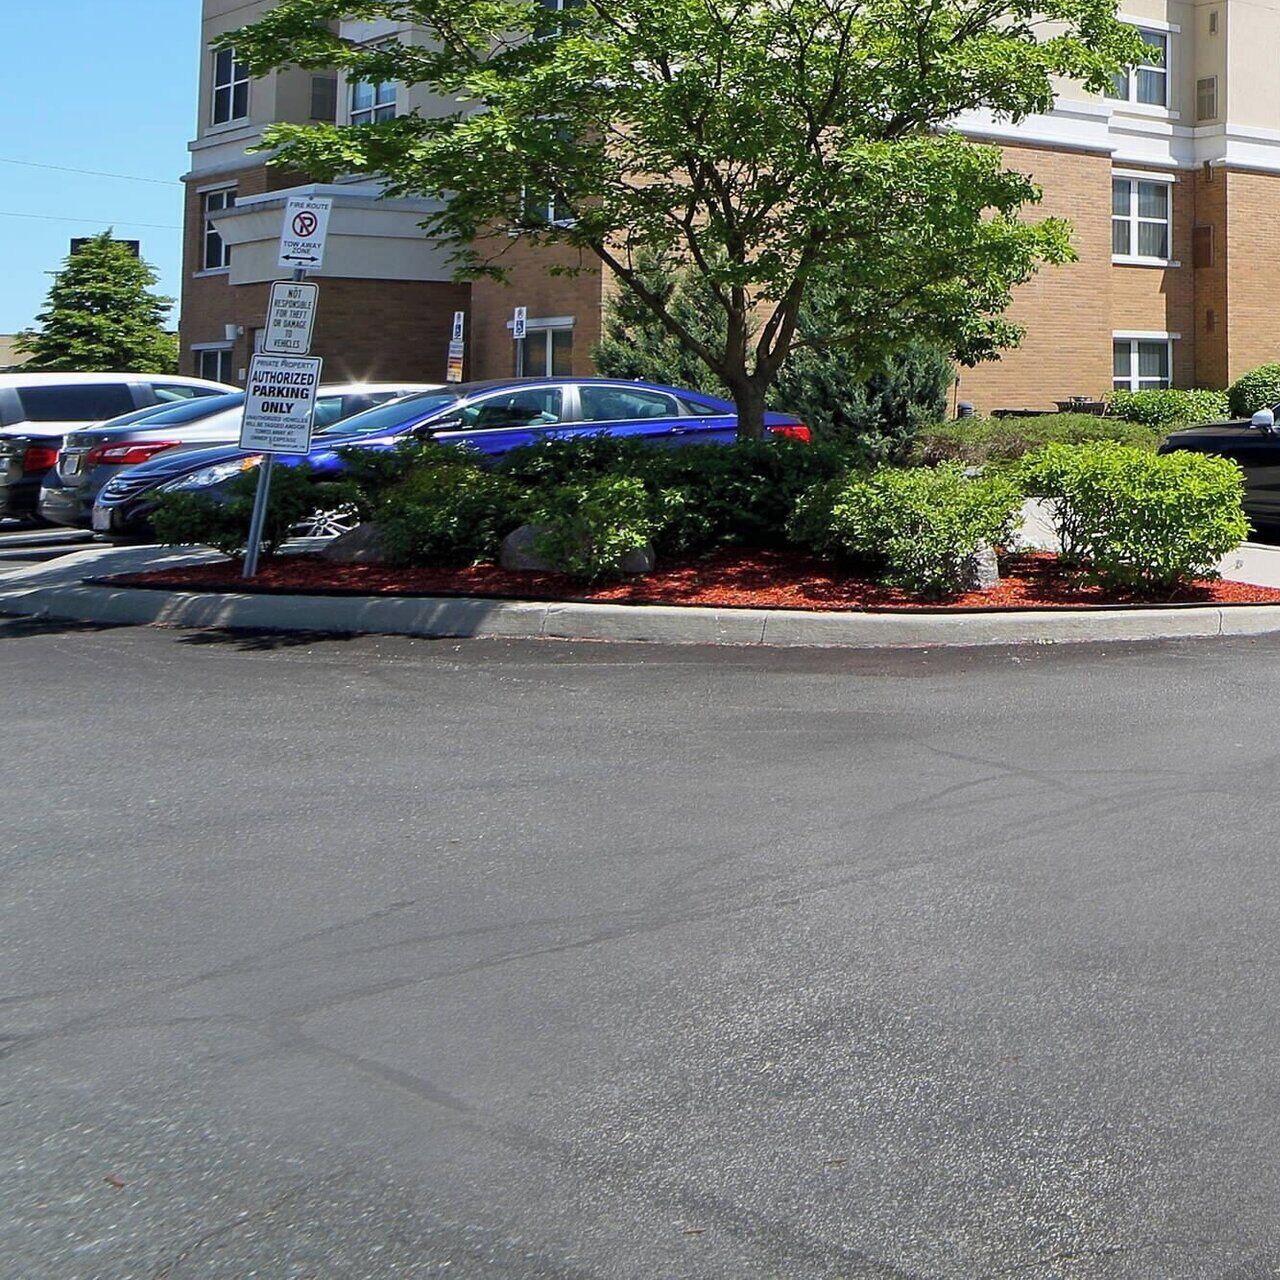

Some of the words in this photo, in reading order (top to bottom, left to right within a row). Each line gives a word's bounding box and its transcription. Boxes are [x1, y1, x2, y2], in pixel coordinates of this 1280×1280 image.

[289, 201, 305, 209] FIRE
[306, 202, 329, 210] ROUTE
[283, 240, 299, 248] TOW
[300, 241, 322, 249] AWAY
[287, 289, 302, 299] NOT
[275, 308, 288, 318] FOR
[289, 309, 308, 319] THEFT
[256, 360, 279, 368] PRIVATE
[280, 360, 315, 369] PROPERTY
[251, 370, 315, 386] AUTHORIZED
[252, 385, 310, 400] PARKING
[261, 401, 295, 414] ONLY
